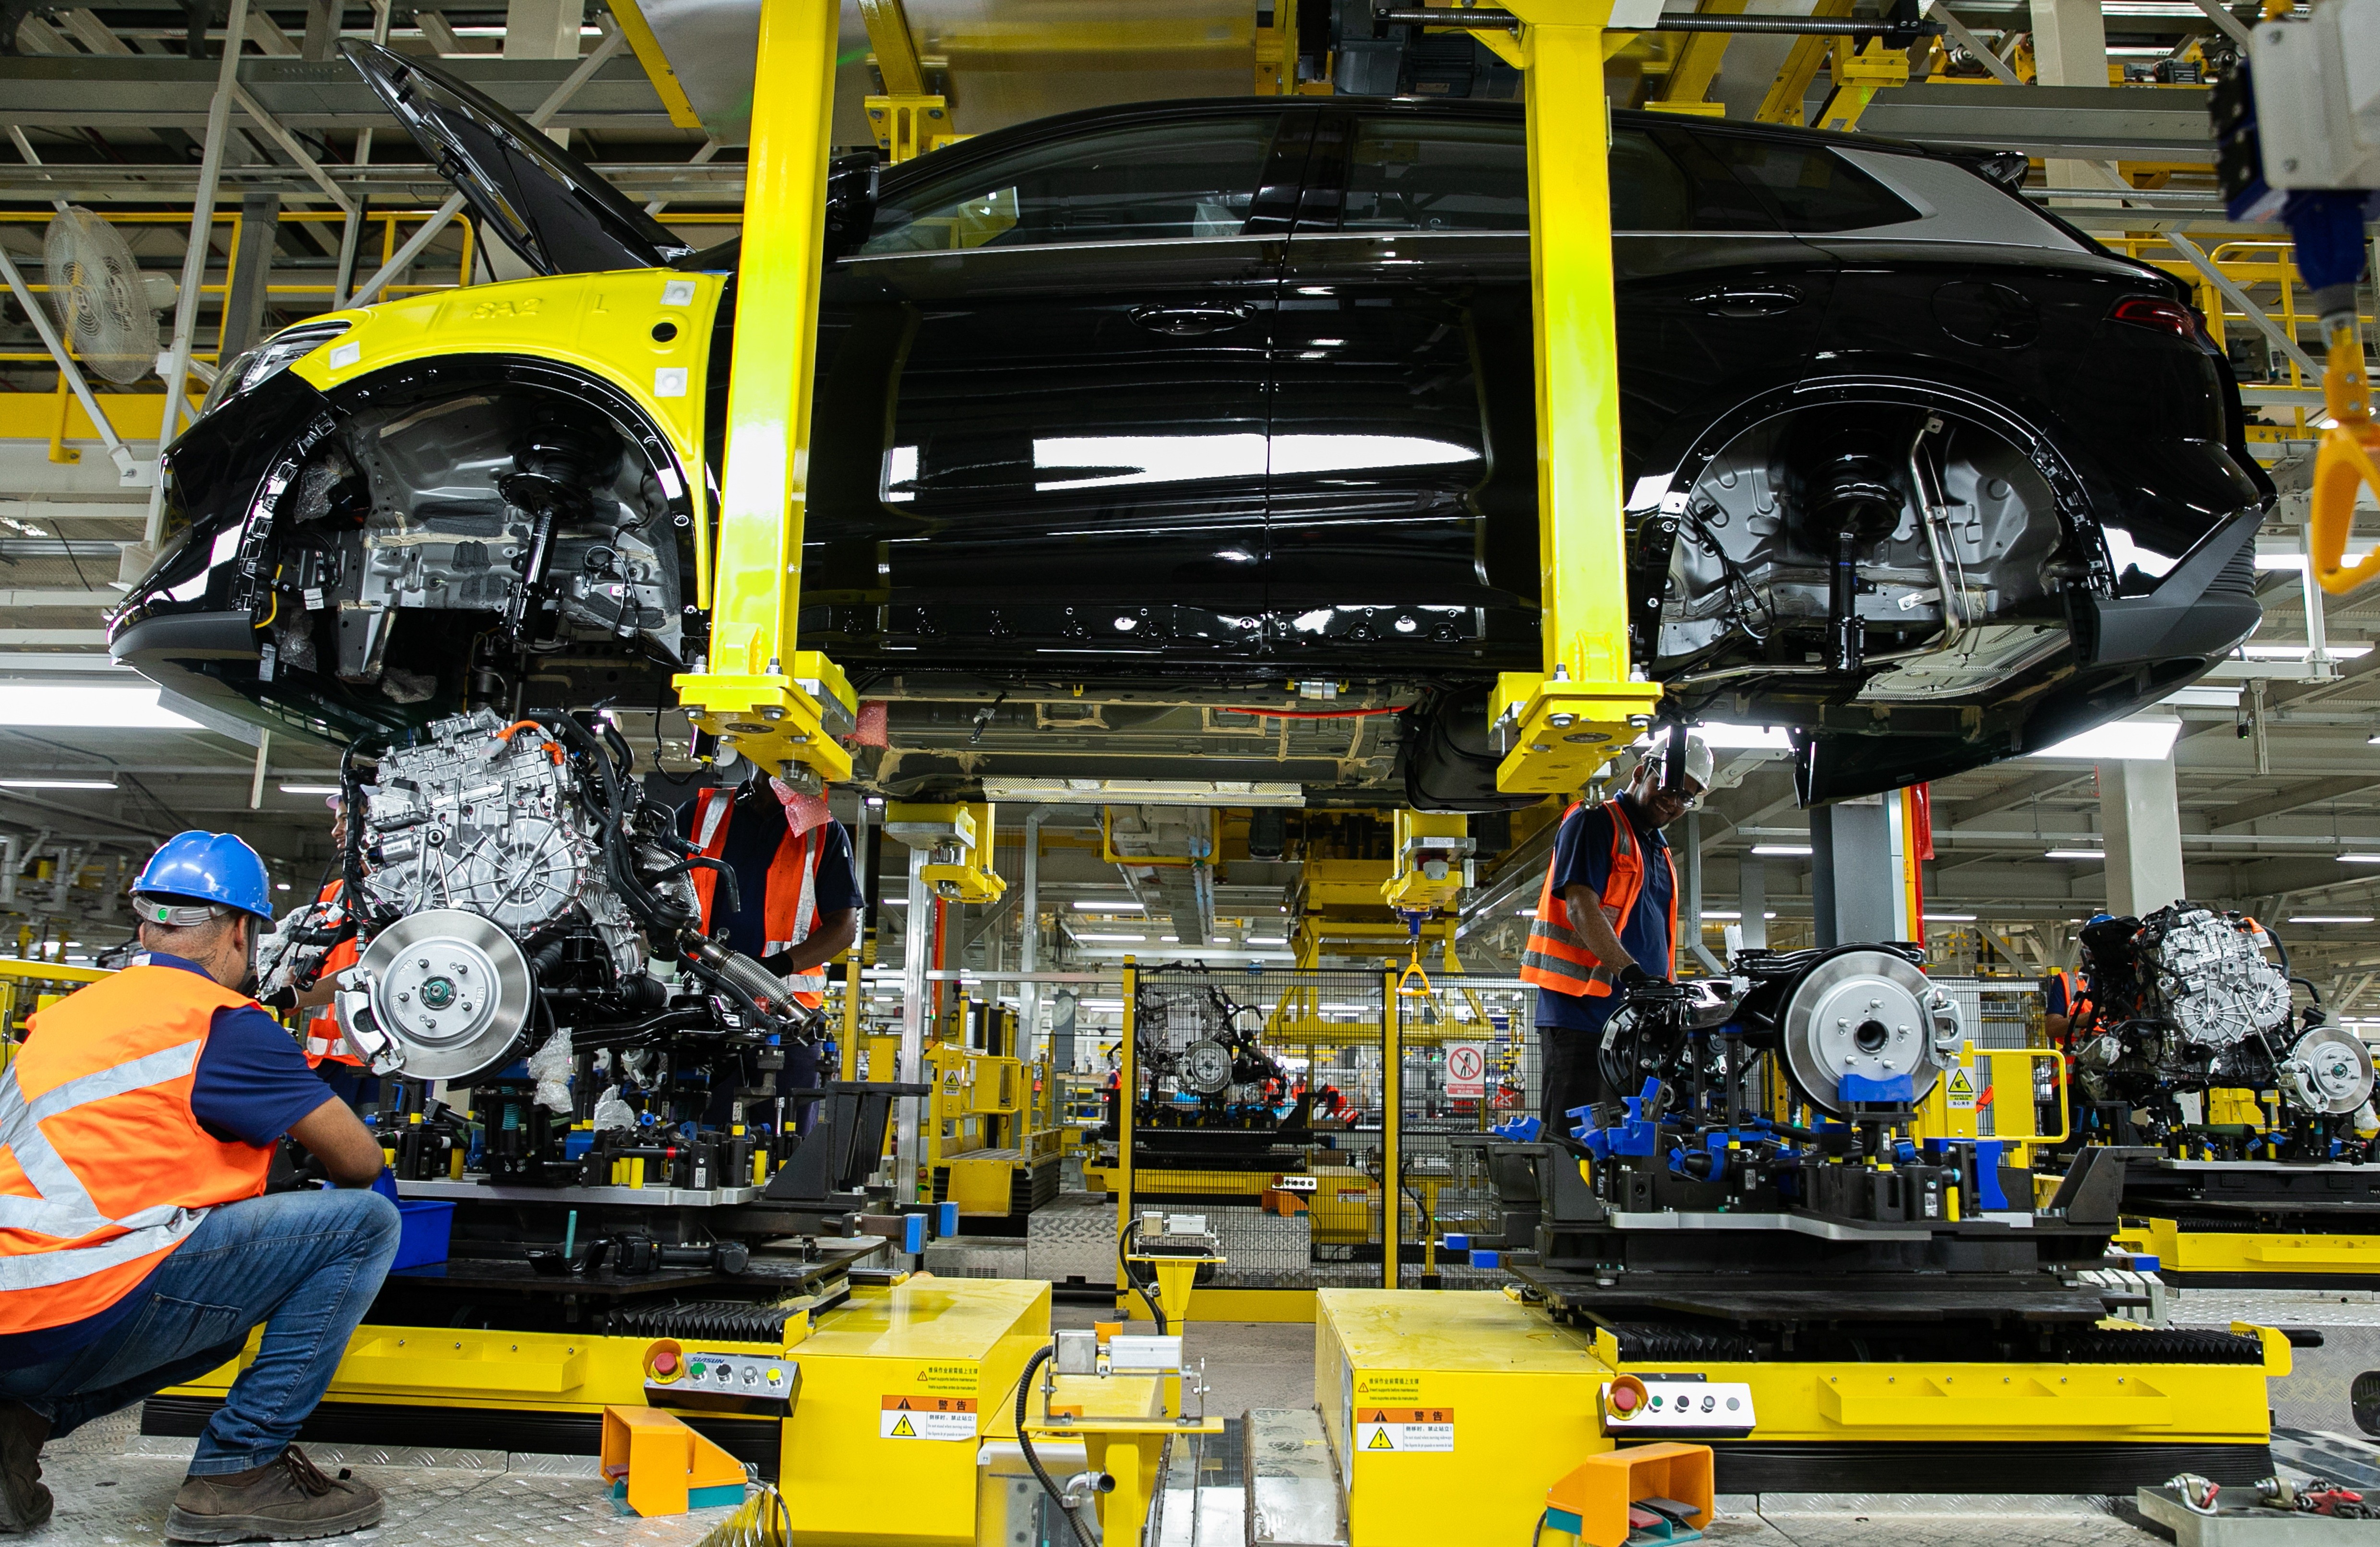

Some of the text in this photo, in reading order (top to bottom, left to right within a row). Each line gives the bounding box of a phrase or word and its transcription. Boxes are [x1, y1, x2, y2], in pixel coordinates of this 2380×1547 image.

[471, 294, 609, 320] SA2 L
[733, 1108, 741, 1118] 27
[696, 1174, 705, 1184] 40
[938, 1399, 966, 1411] 警告
[1414, 1411, 1443, 1421] 警告
